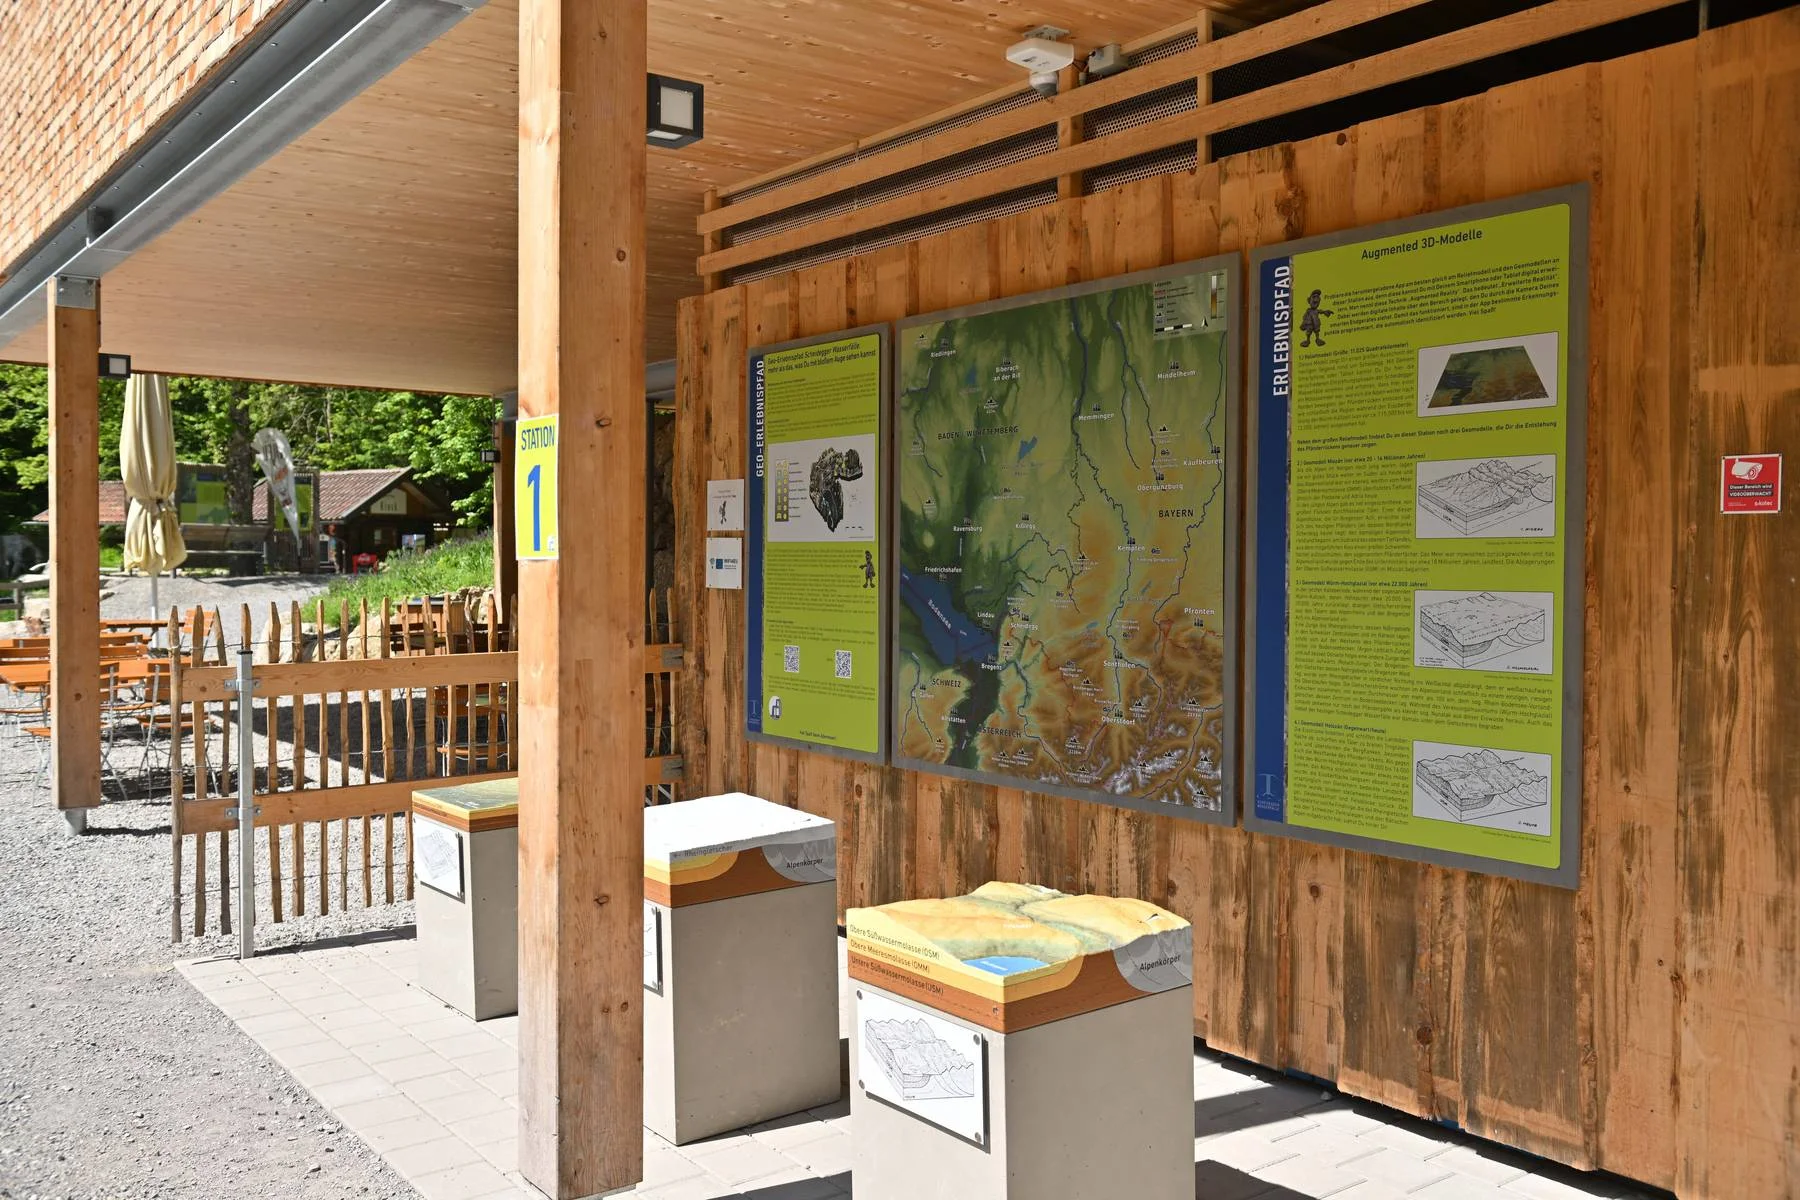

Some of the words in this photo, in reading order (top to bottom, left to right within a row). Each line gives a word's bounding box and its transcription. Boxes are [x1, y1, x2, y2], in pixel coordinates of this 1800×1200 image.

[1362, 239, 1418, 260] Augmented
[1422, 229, 1482, 250] 3D-Modelle
[1274, 265, 1290, 396] ERLEBNISPFAD
[1157, 370, 1196, 380] Mindelheim
[756, 360, 764, 477] GEO-ERLEBNISPFAD
[521, 424, 554, 450] STATION
[528, 464, 540, 551] 1
[1158, 509, 1194, 518] BAYERN
[932, 678, 961, 688] SCHWEIZ
[976, 725, 1022, 738] STERREICH
[786, 856, 823, 869] Alpenkörper
[850, 924, 866, 937] Obere
[866, 928, 922, 954] Süßwassermolasse
[921, 946, 940, 960] (OSM)
[850, 939, 867, 951] Obere
[867, 944, 911, 966] Meeresmolasse
[911, 960, 930, 973] (OMM)
[851, 955, 869, 969] Untere
[870, 961, 926, 989] Süßwassermolasse
[925, 981, 944, 996] (USM)
[1140, 954, 1181, 971] Alpenkörper
